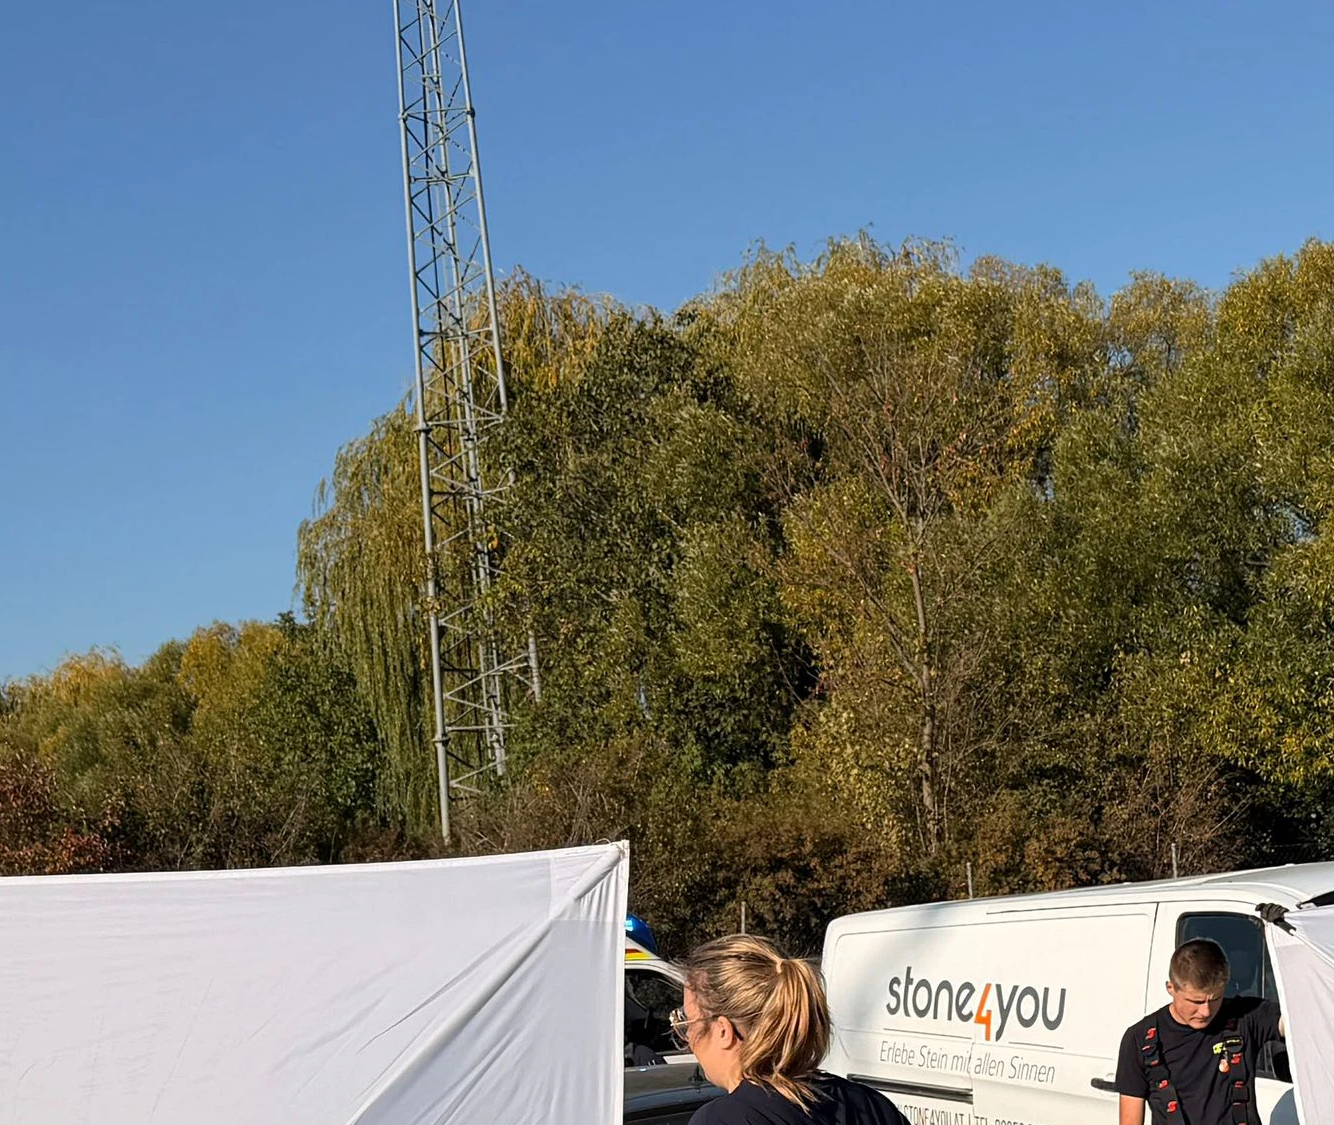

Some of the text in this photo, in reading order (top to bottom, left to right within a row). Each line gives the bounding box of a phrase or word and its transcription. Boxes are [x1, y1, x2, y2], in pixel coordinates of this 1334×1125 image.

[886, 966, 1066, 1042] stone4you
[880, 1041, 1056, 1084] Erlebe Stein mit allen Sinnen
